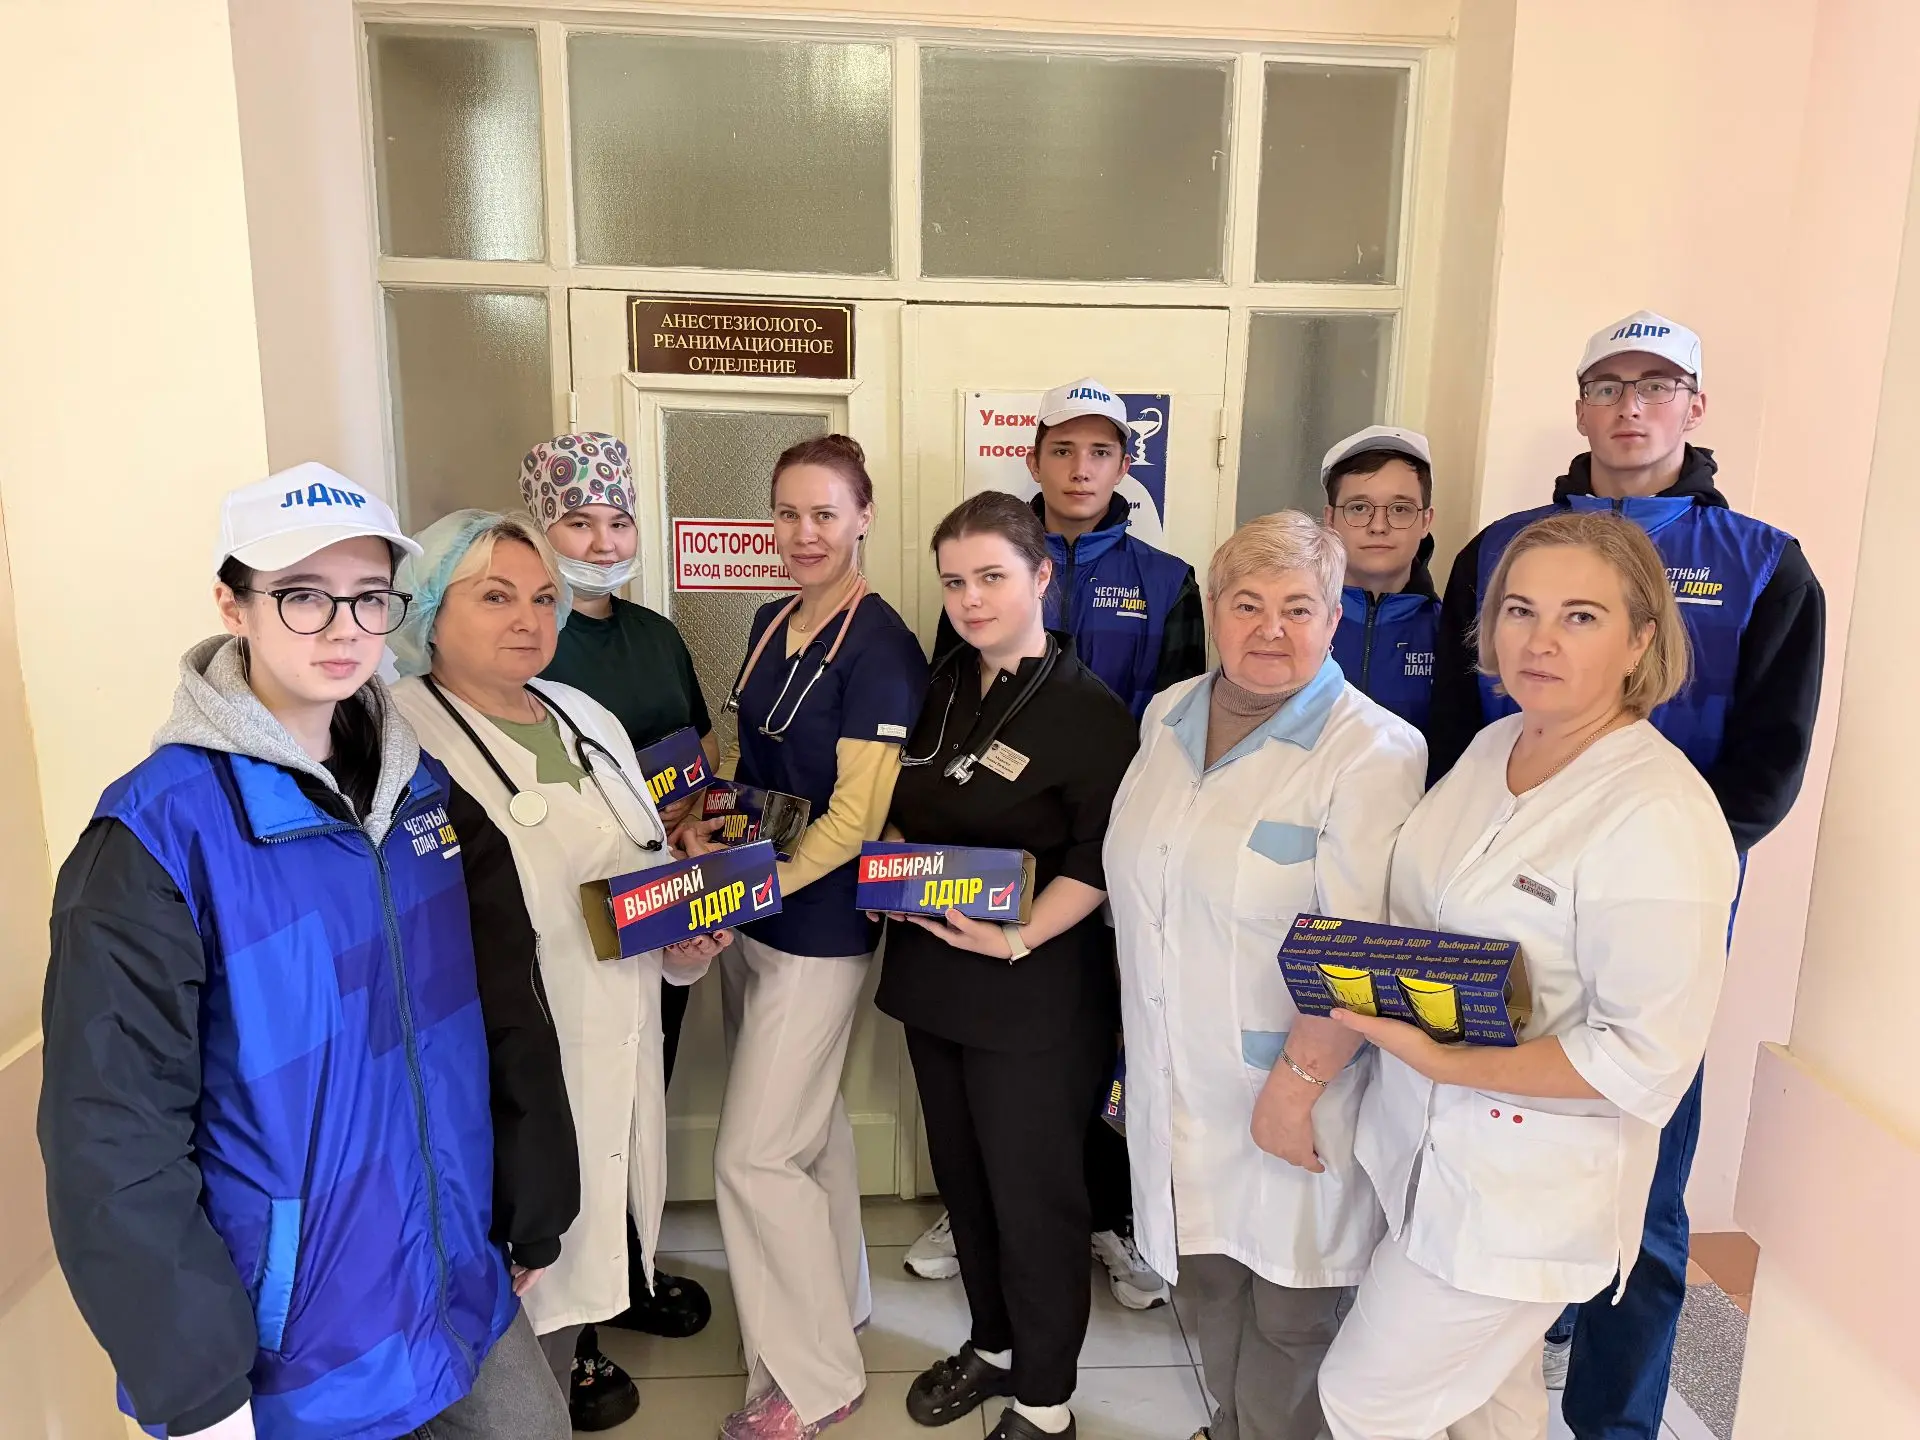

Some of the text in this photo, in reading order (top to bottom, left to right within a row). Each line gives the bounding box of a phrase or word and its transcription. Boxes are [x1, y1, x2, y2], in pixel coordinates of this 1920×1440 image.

[661, 313, 823, 333] АНЕСТЕЗИОЛОГО-
[1610, 323, 1671, 341] ЛДПР
[653, 334, 834, 354] РЕАНИМАЦИОННОЕ
[689, 356, 797, 374] ОТДЕЛЕНИЕ
[1067, 387, 1111, 403] ЛДПР
[979, 409, 1037, 427] Уваж
[979, 445, 1035, 458] посе
[280, 482, 366, 508] ЛДПР
[682, 532, 780, 555] ПОСТОРОН
[684, 564, 791, 580] ВХОД ВОСПРЕЩ
[1664, 567, 1711, 580] СТНЫЙ
[1094, 586, 1140, 598] ЧЕСТНЫЙ
[1680, 581, 1723, 596] ЛДПР
[1092, 598, 1119, 608] ПЛАН
[1404, 664, 1432, 676] ПЛАН
[706, 788, 737, 810] ВЫБИРАЙ
[723, 815, 748, 841] ЛДПР
[412, 832, 439, 857] ПЛАН
[868, 851, 945, 880] ВЫБИРАЙ
[623, 864, 705, 920] ВЫБИРАЙ
[920, 877, 983, 910] ЛДПР
[688, 880, 746, 931] ЛДПР
[1309, 919, 1343, 931] ЛДПР
[1293, 932, 1510, 952] Выбирай ЛДПР Выбирай ЛДПР Выбирай ЛДПР
[1425, 969, 1469, 981] Выбирай
[1470, 972, 1498, 982] ЛДПР
[1473, 1004, 1498, 1013] ЛДПР
[1483, 1029, 1506, 1039] ЛДПР
[1110, 1080, 1122, 1105] ЛДПР
